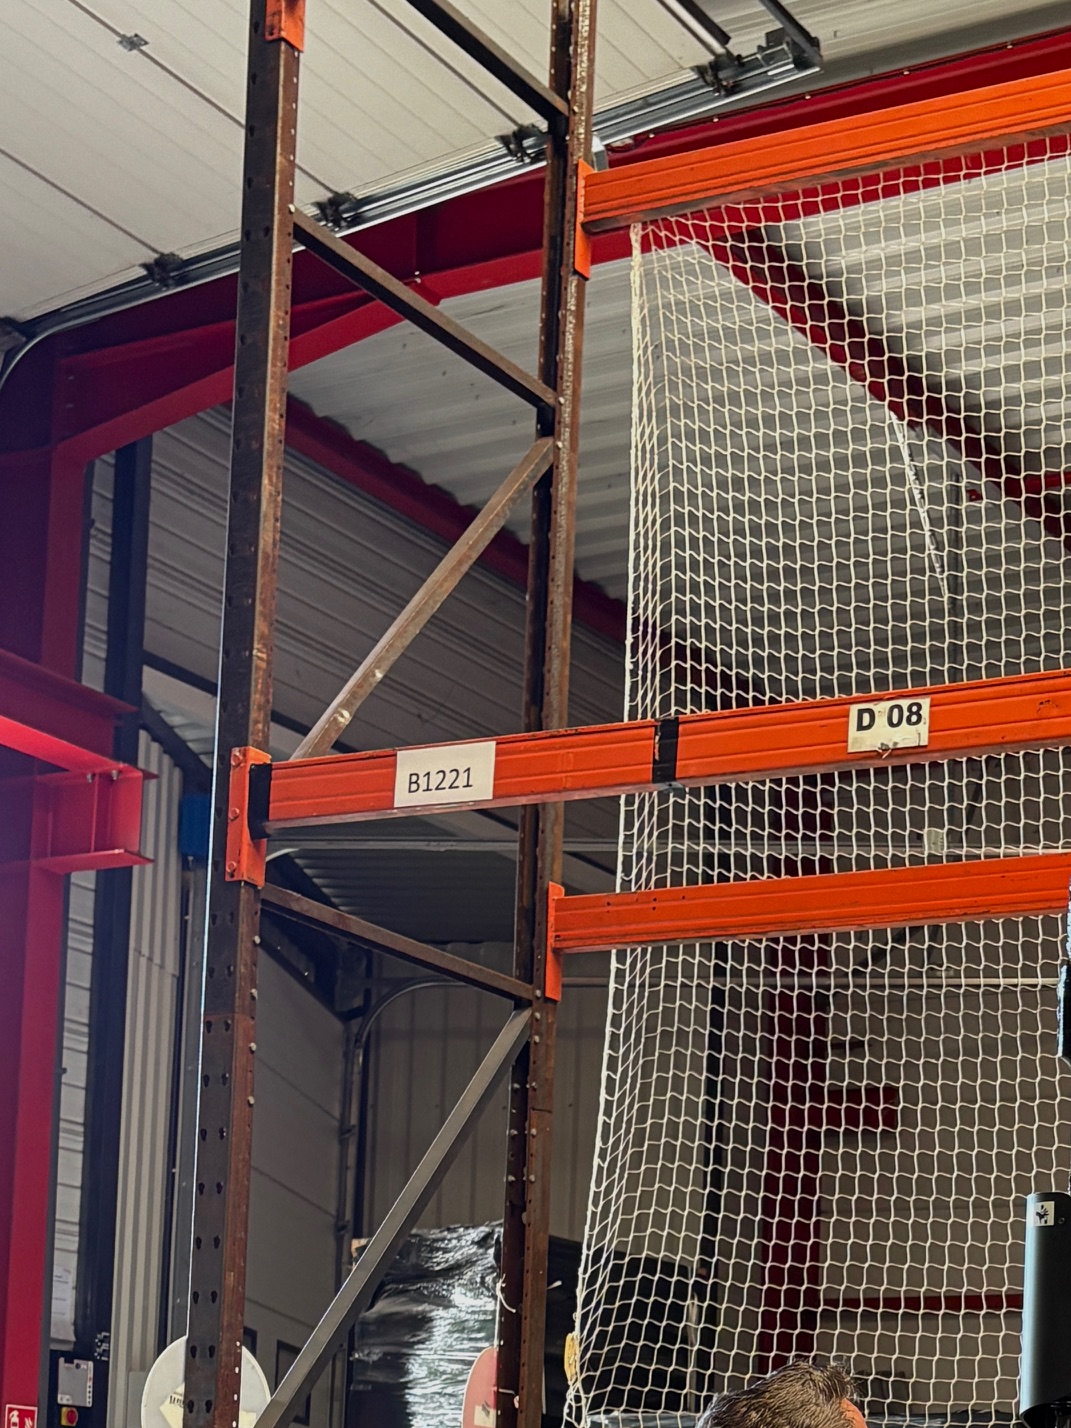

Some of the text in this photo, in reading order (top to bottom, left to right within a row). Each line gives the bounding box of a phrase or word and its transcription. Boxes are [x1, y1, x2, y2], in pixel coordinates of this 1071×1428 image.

[856, 701, 923, 732] D 08
[407, 766, 474, 794] B1221
